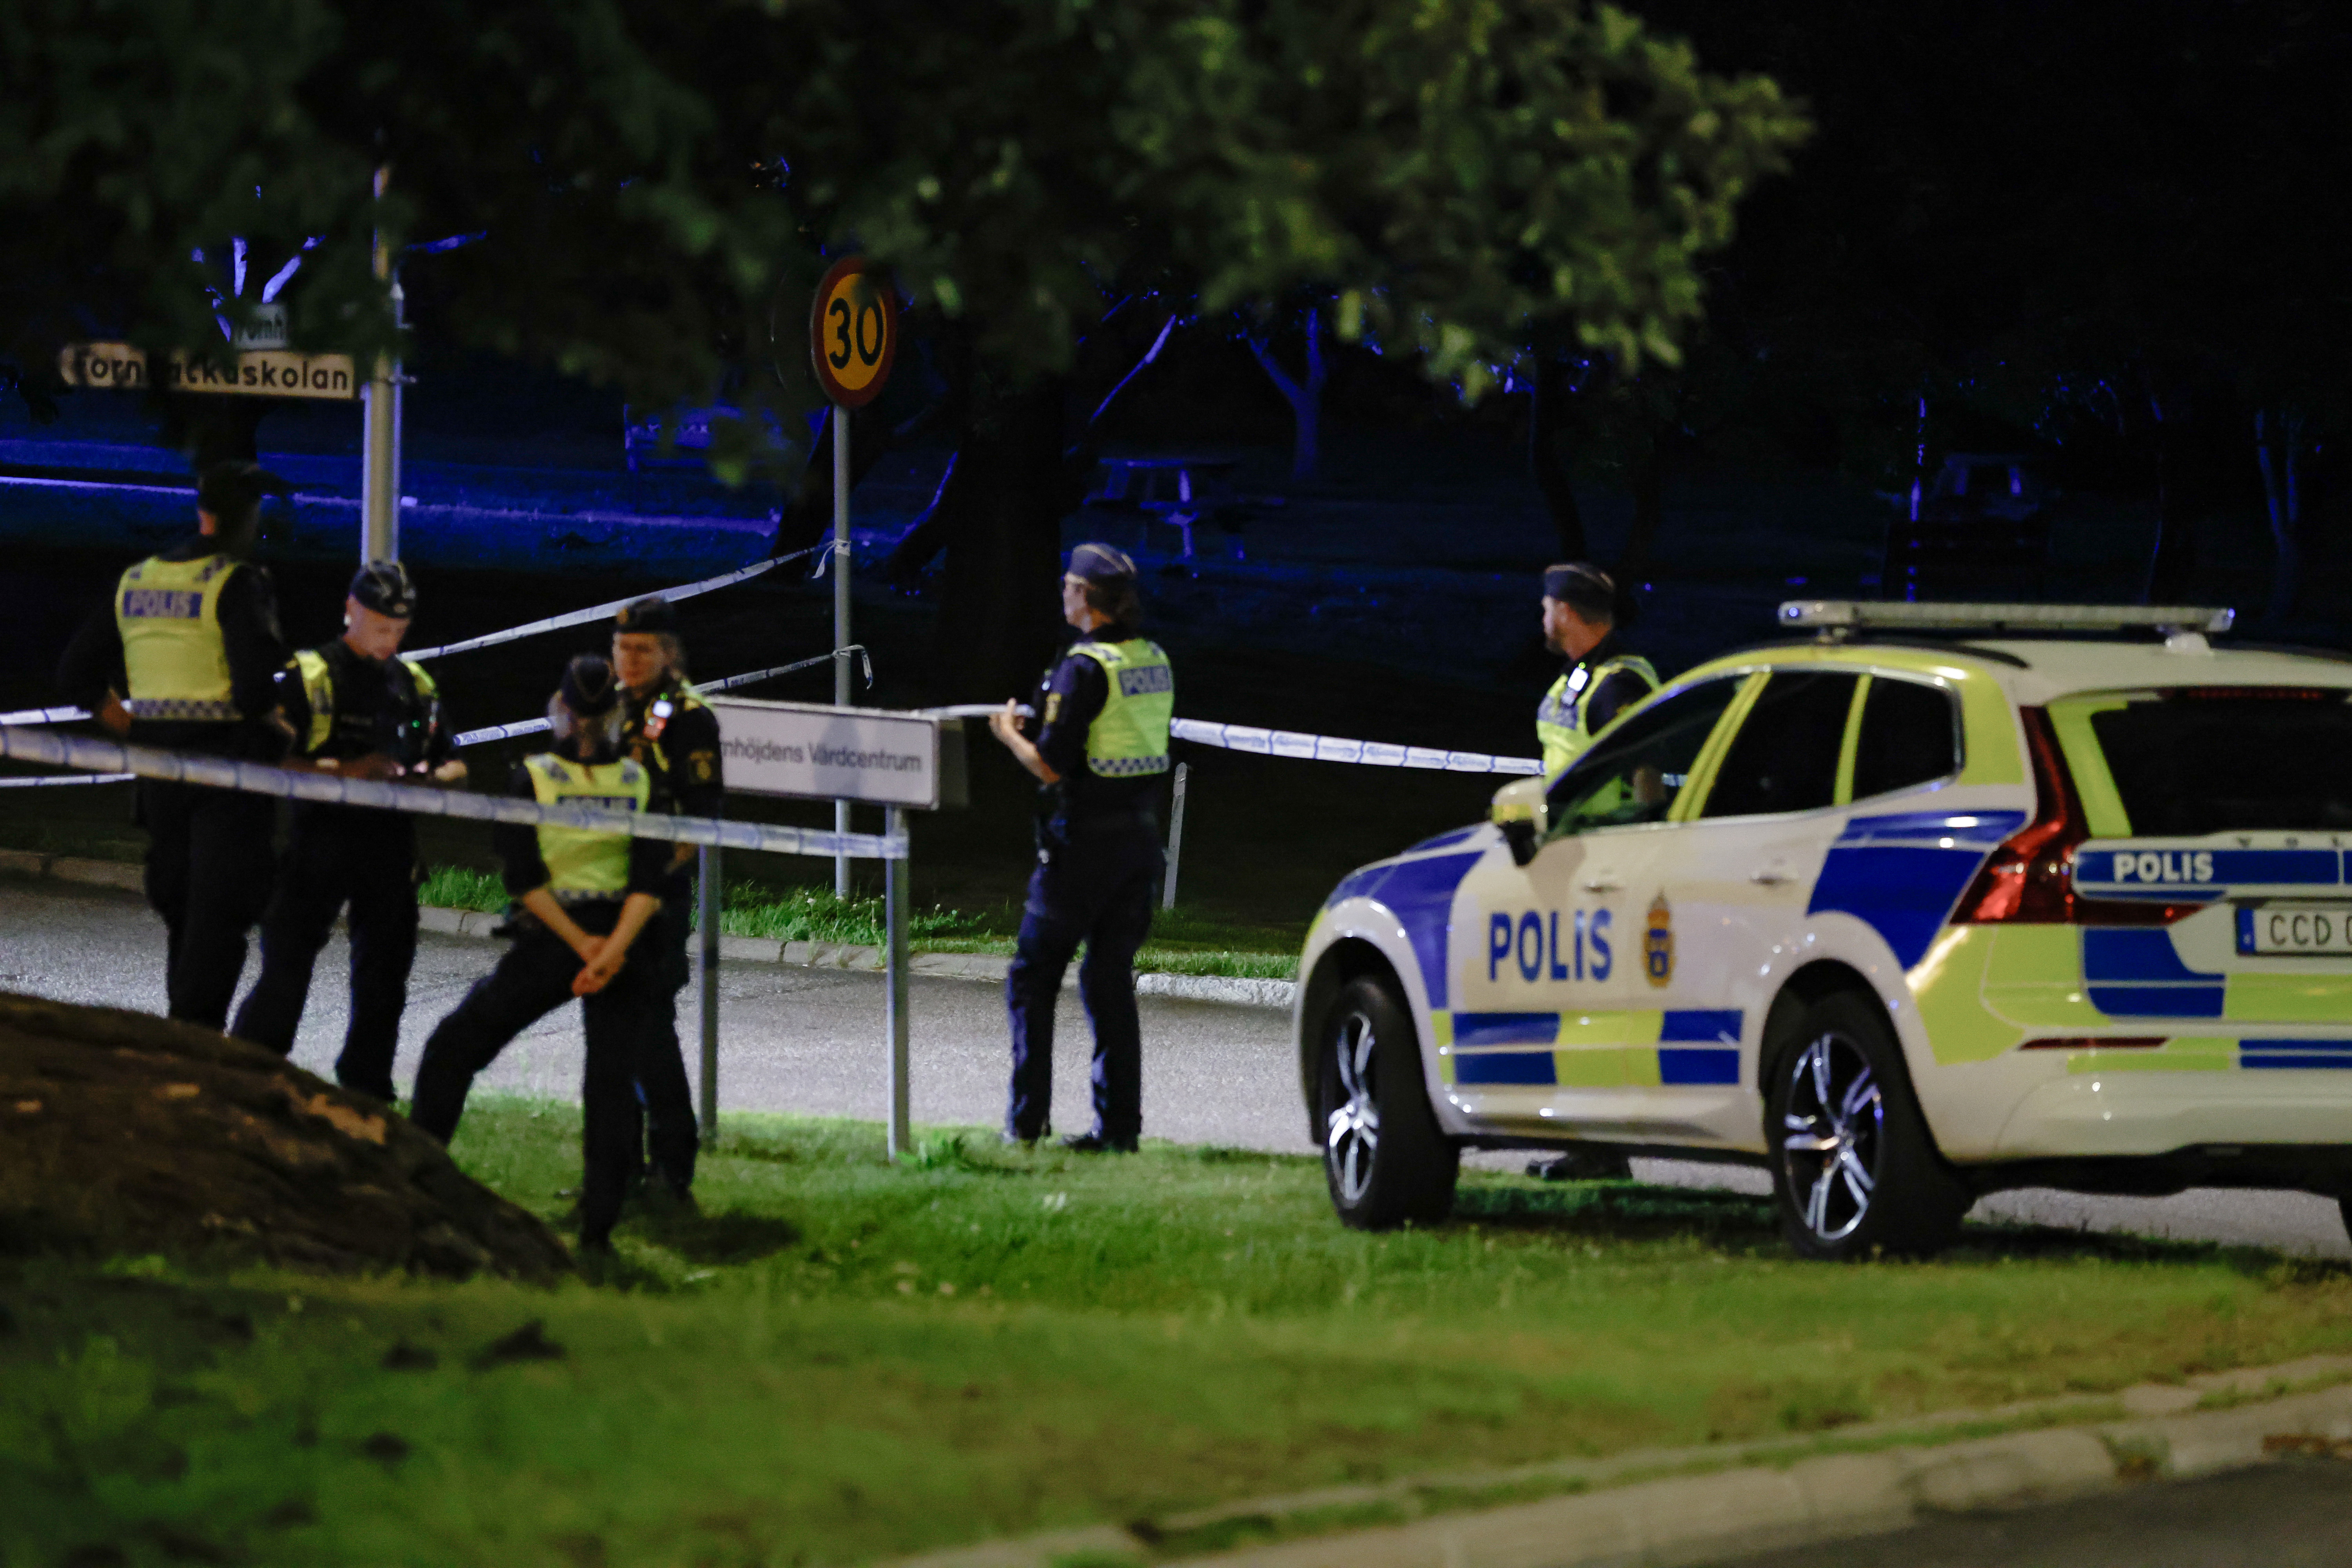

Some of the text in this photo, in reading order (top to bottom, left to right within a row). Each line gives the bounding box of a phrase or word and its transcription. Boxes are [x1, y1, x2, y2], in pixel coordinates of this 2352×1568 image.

[829, 298, 884, 369] 30
[129, 590, 191, 619] POLIS
[1120, 665, 1171, 696] POLIS
[721, 737, 804, 765] nhöjdens
[2112, 852, 2214, 882] POLIS
[1490, 909, 1612, 981] POLIS
[2270, 915, 2330, 946] CCD
